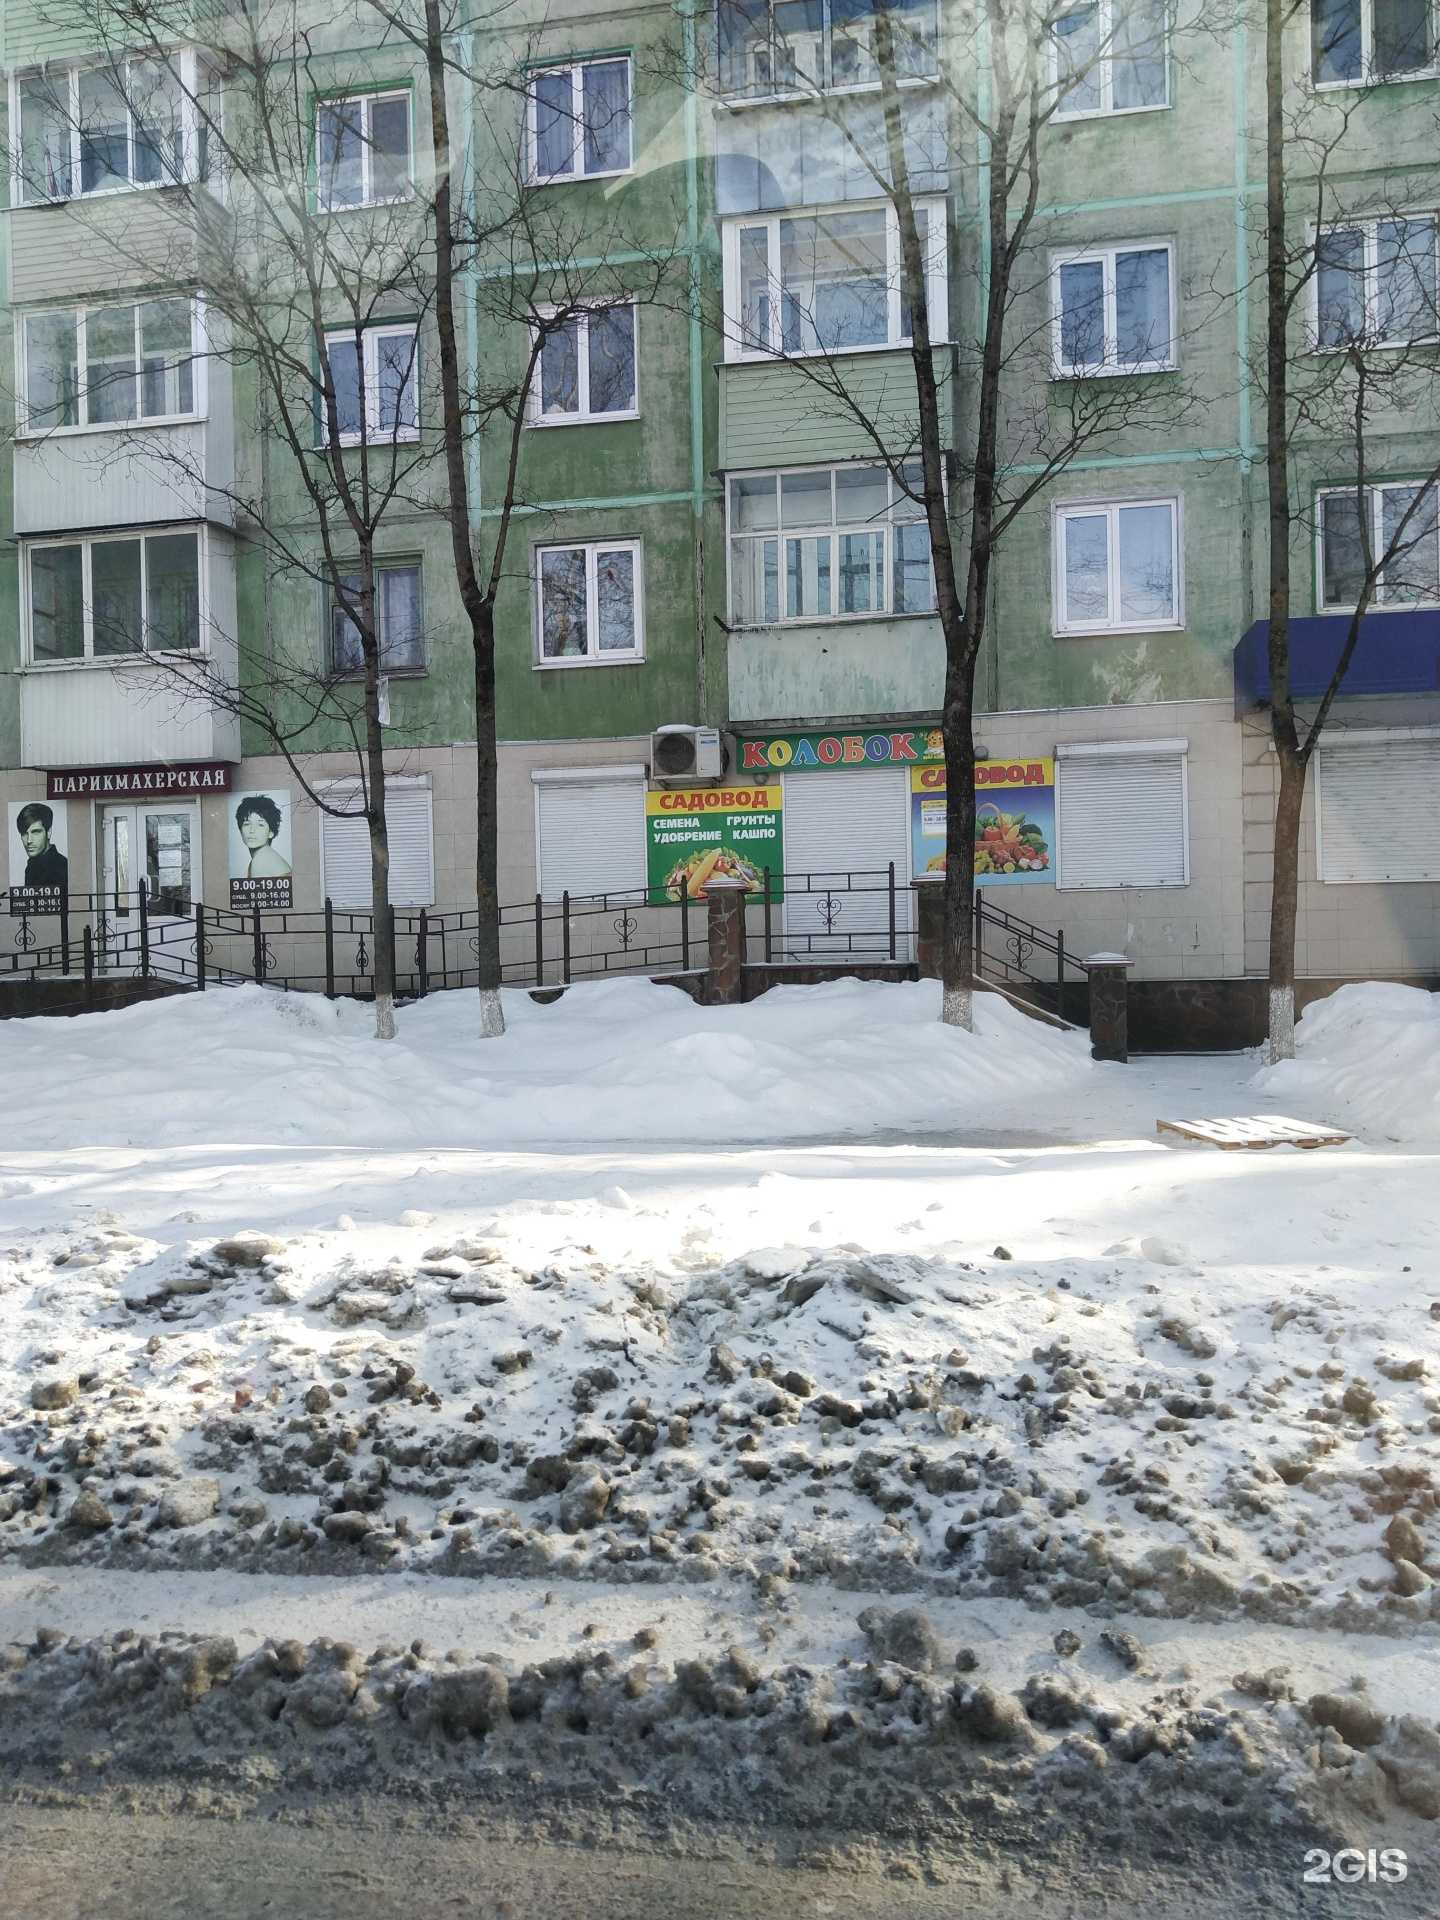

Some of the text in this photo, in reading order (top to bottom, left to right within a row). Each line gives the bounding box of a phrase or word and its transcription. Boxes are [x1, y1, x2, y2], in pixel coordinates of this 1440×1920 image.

[743, 733, 918, 768] КОЛОБОК
[53, 769, 226, 793] ПАРИКМАХЕРСКАЯ
[921, 763, 1045, 787] САОВОД
[660, 790, 769, 811] САДОВОД
[653, 815, 776, 829] СЕМЕНА ГРУНТЫ
[653, 829, 776, 844] УДОБРЕНИЕ КАШПО
[233, 880, 290, 891] 9.00-19.00
